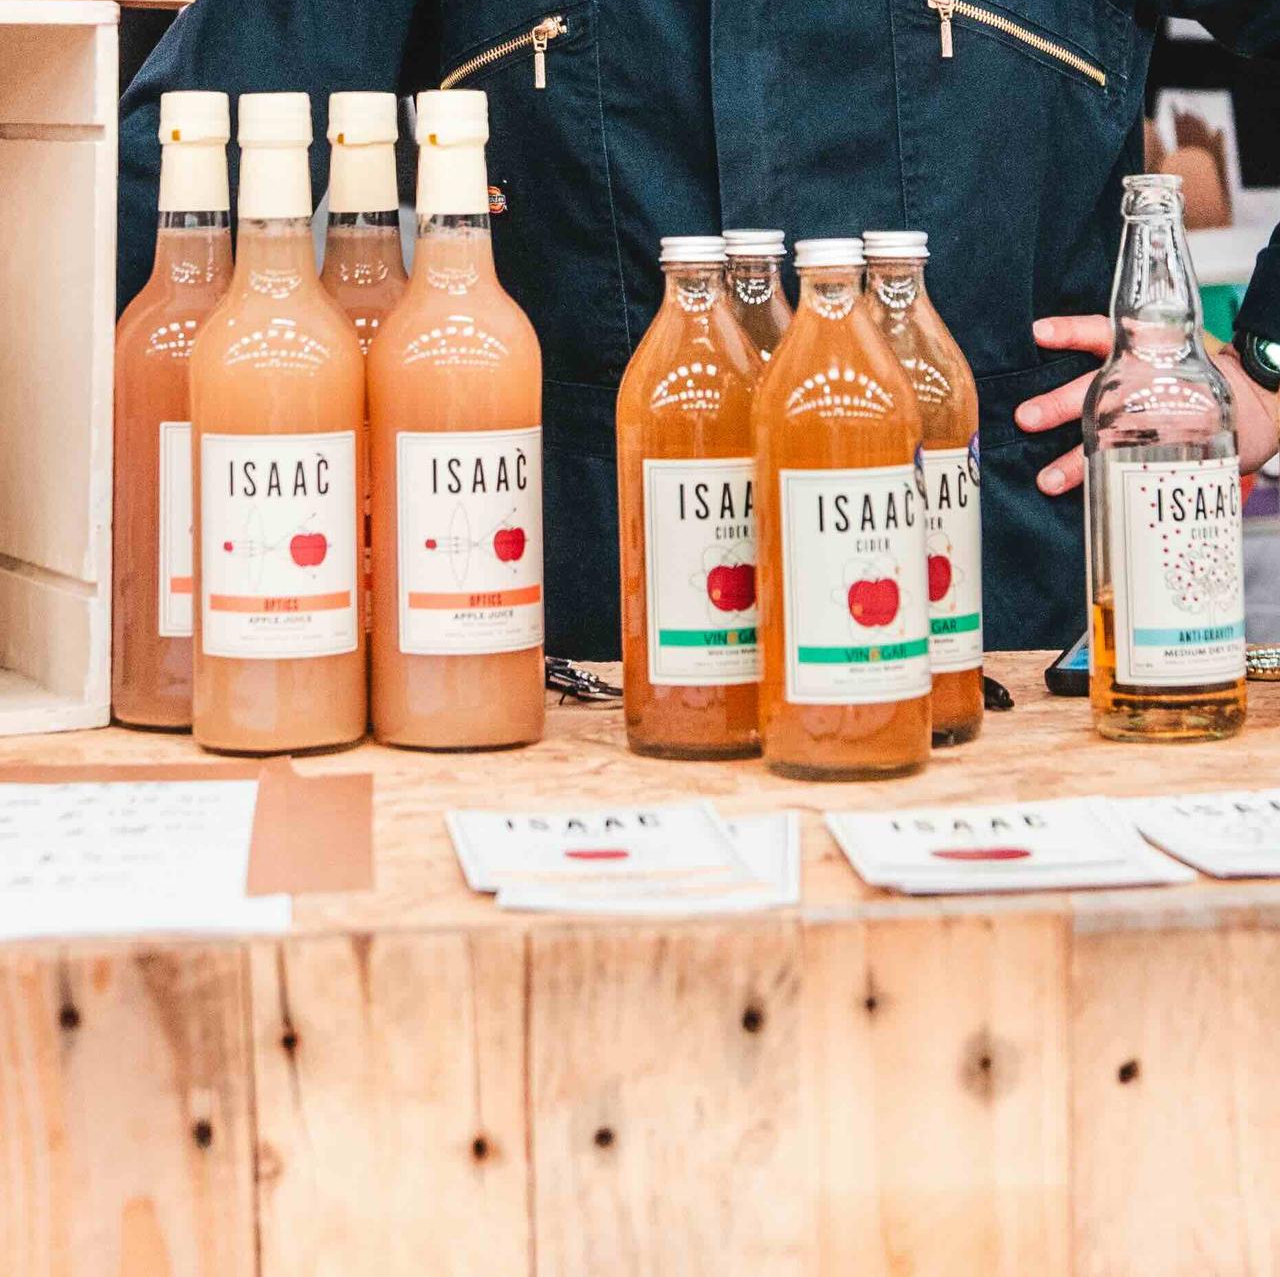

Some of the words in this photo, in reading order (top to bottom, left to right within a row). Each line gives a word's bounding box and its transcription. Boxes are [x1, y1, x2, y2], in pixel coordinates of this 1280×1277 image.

[229, 453, 330, 497] ISAAC
[432, 448, 527, 494] ISAAC
[679, 481, 756, 520] ISAA
[715, 526, 749, 540] CIDER
[1190, 527, 1220, 540] CIDER
[469, 594, 504, 607] OPTICS
[1179, 625, 1234, 643] ANTI-GRAVITY
[1164, 649, 1206, 657] MEDIUM
